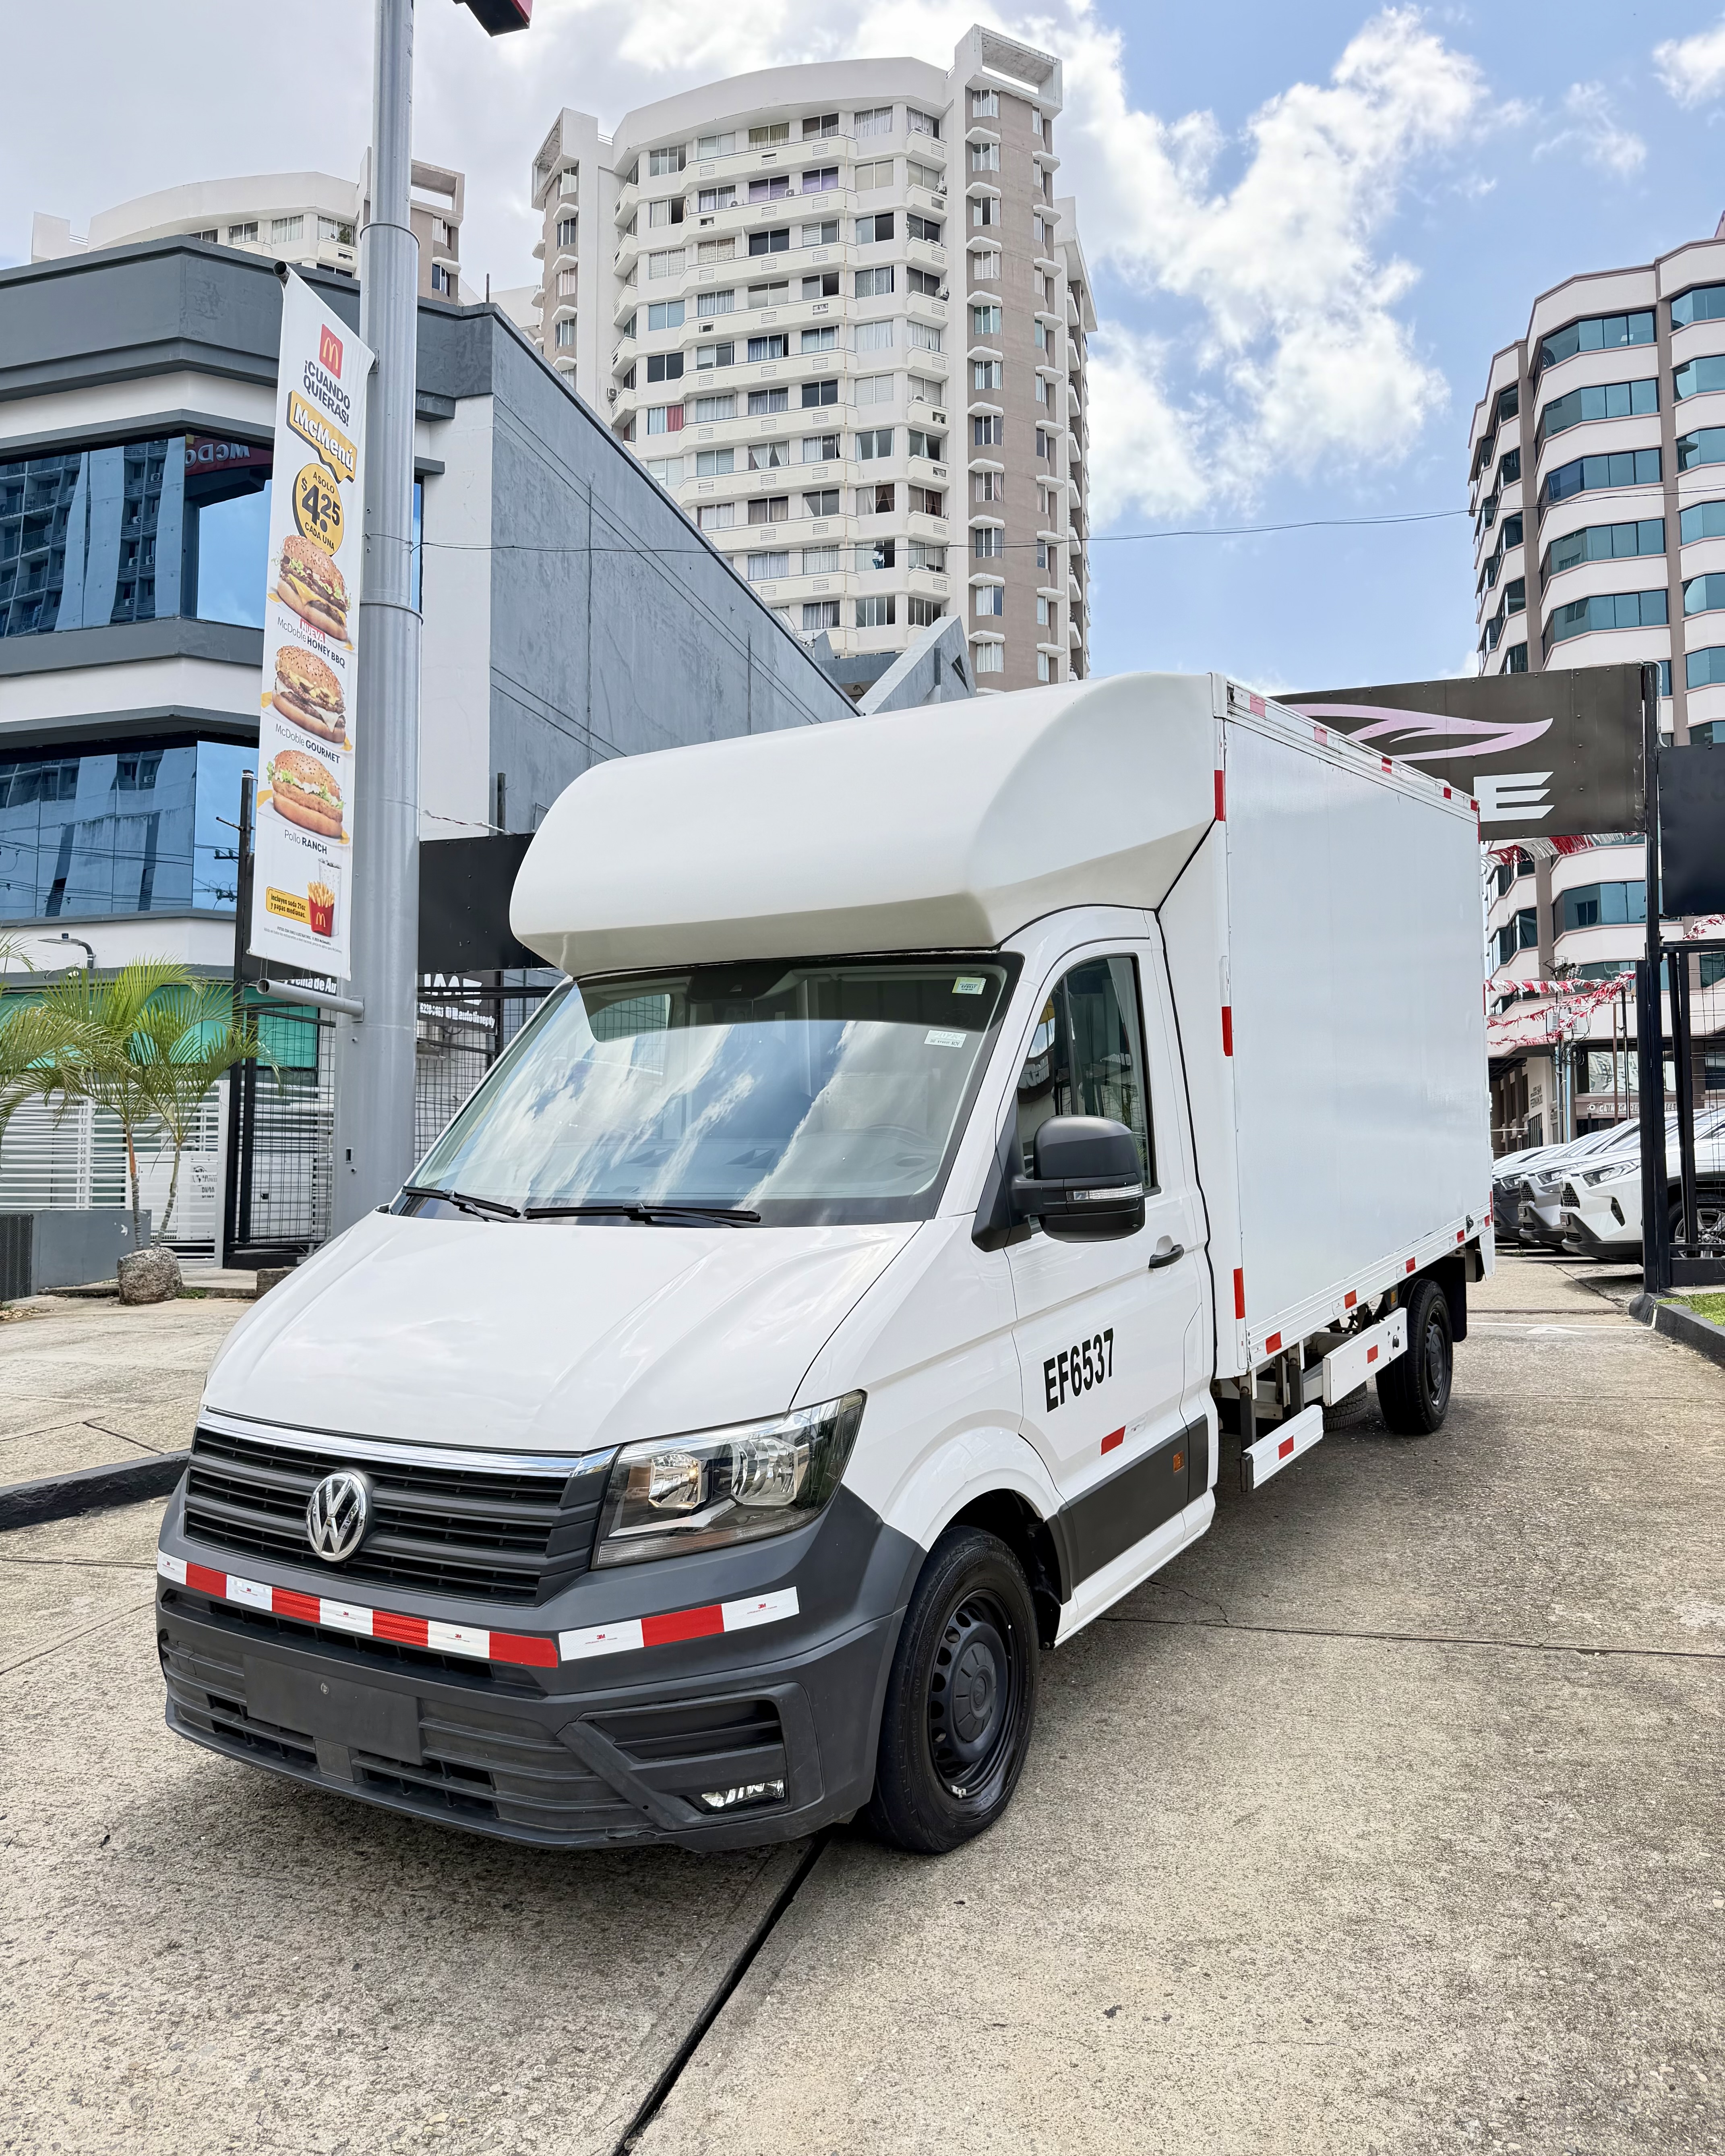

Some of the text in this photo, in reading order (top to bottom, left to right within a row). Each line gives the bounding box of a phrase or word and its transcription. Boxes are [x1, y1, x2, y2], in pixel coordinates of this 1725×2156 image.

[304, 360, 350, 410] ¡CUANDO
[303, 375, 350, 427] QUIERAS!
[294, 403, 354, 472] McMenú
[317, 476, 335, 494] SOLO
[305, 522, 335, 551] CADA UNA
[277, 617, 345, 668] McDoble HONEY BBQ
[302, 621, 324, 642] NUEVA
[275, 723, 340, 763] McDoble GOURMET
[285, 829, 327, 855] Pollo RANCH
[271, 894, 287, 904] Incluyen
[274, 904, 285, 912] papas
[314, 978, 325, 991] de
[1599, 1104, 1627, 1112] CLINCA
[1043, 1327, 1113, 1413] EF6537
